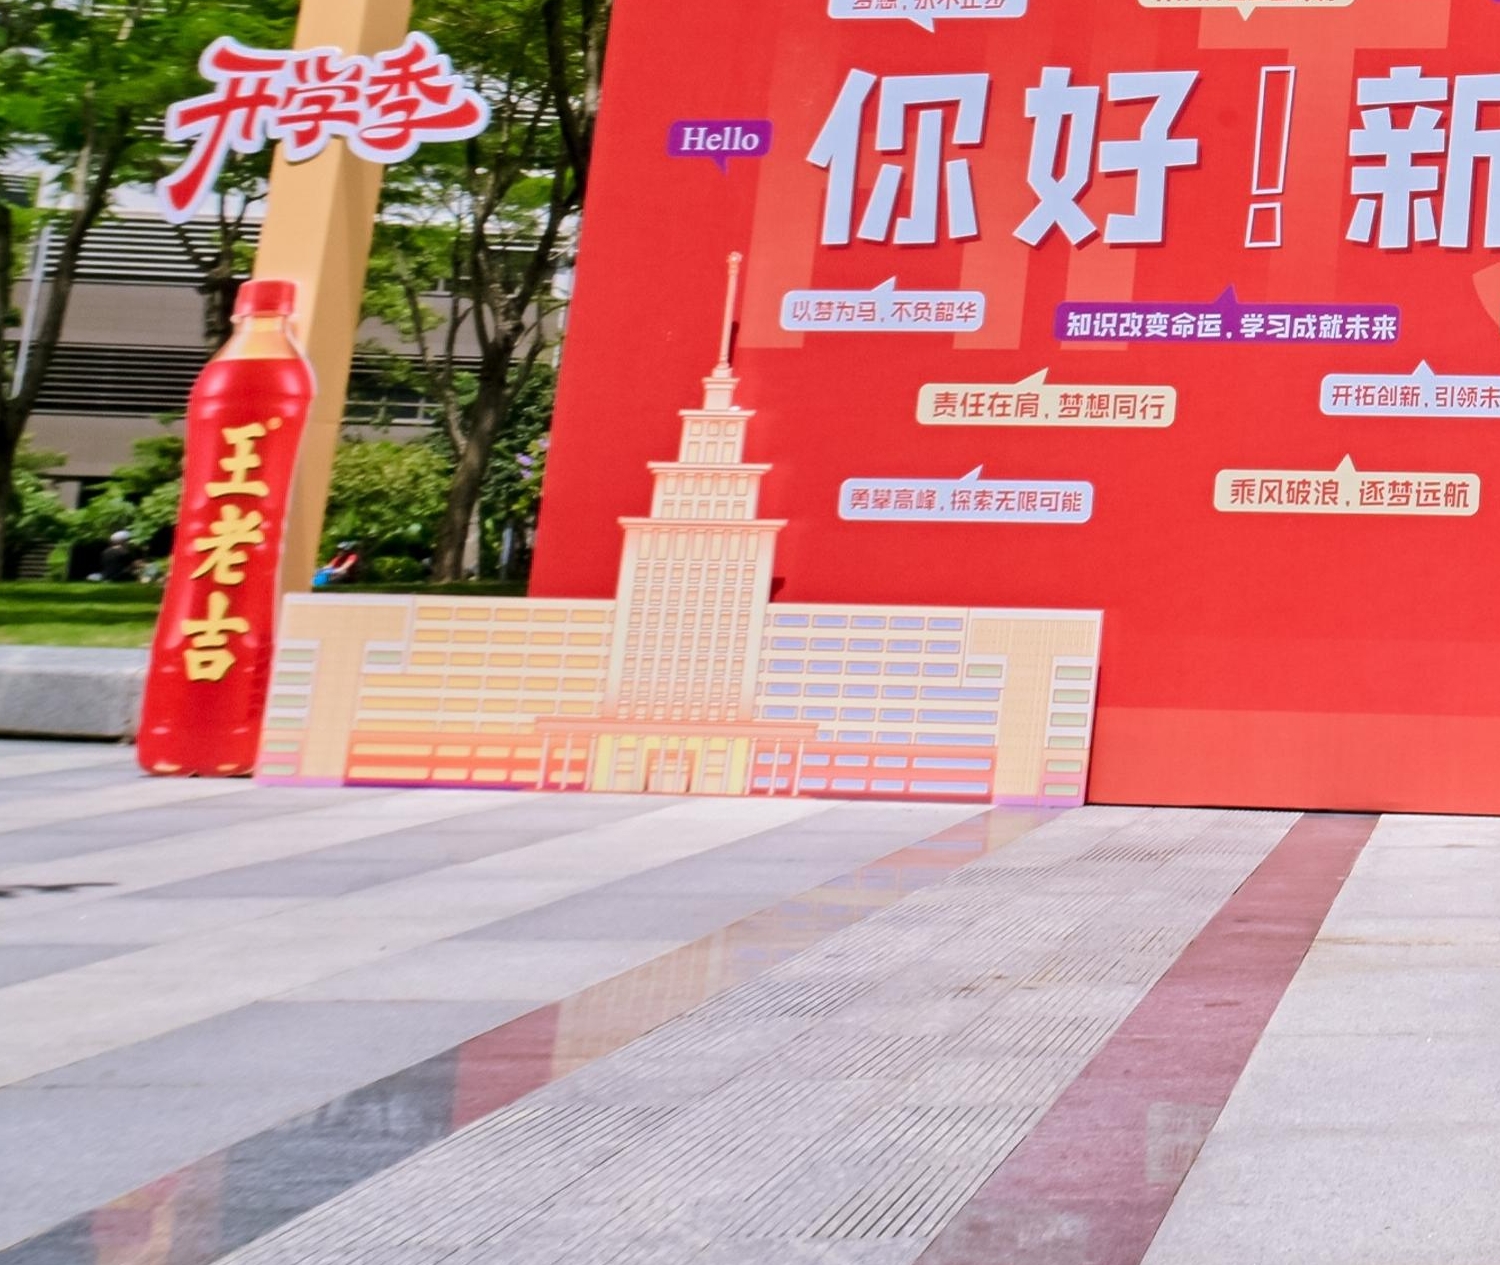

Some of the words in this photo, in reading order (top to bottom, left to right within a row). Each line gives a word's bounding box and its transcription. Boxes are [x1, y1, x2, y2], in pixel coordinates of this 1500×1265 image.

[167, 43, 479, 212] 开学季
[680, 126, 760, 154] Hello
[1066, 312, 1398, 341] 知识改变命运，学习成就未来
[932, 391, 1166, 422] 责任在肩，梦想同行
[1229, 477, 1470, 509] 乘风破浪，逐梦远航
[180, 418, 272, 683] 王老吉
